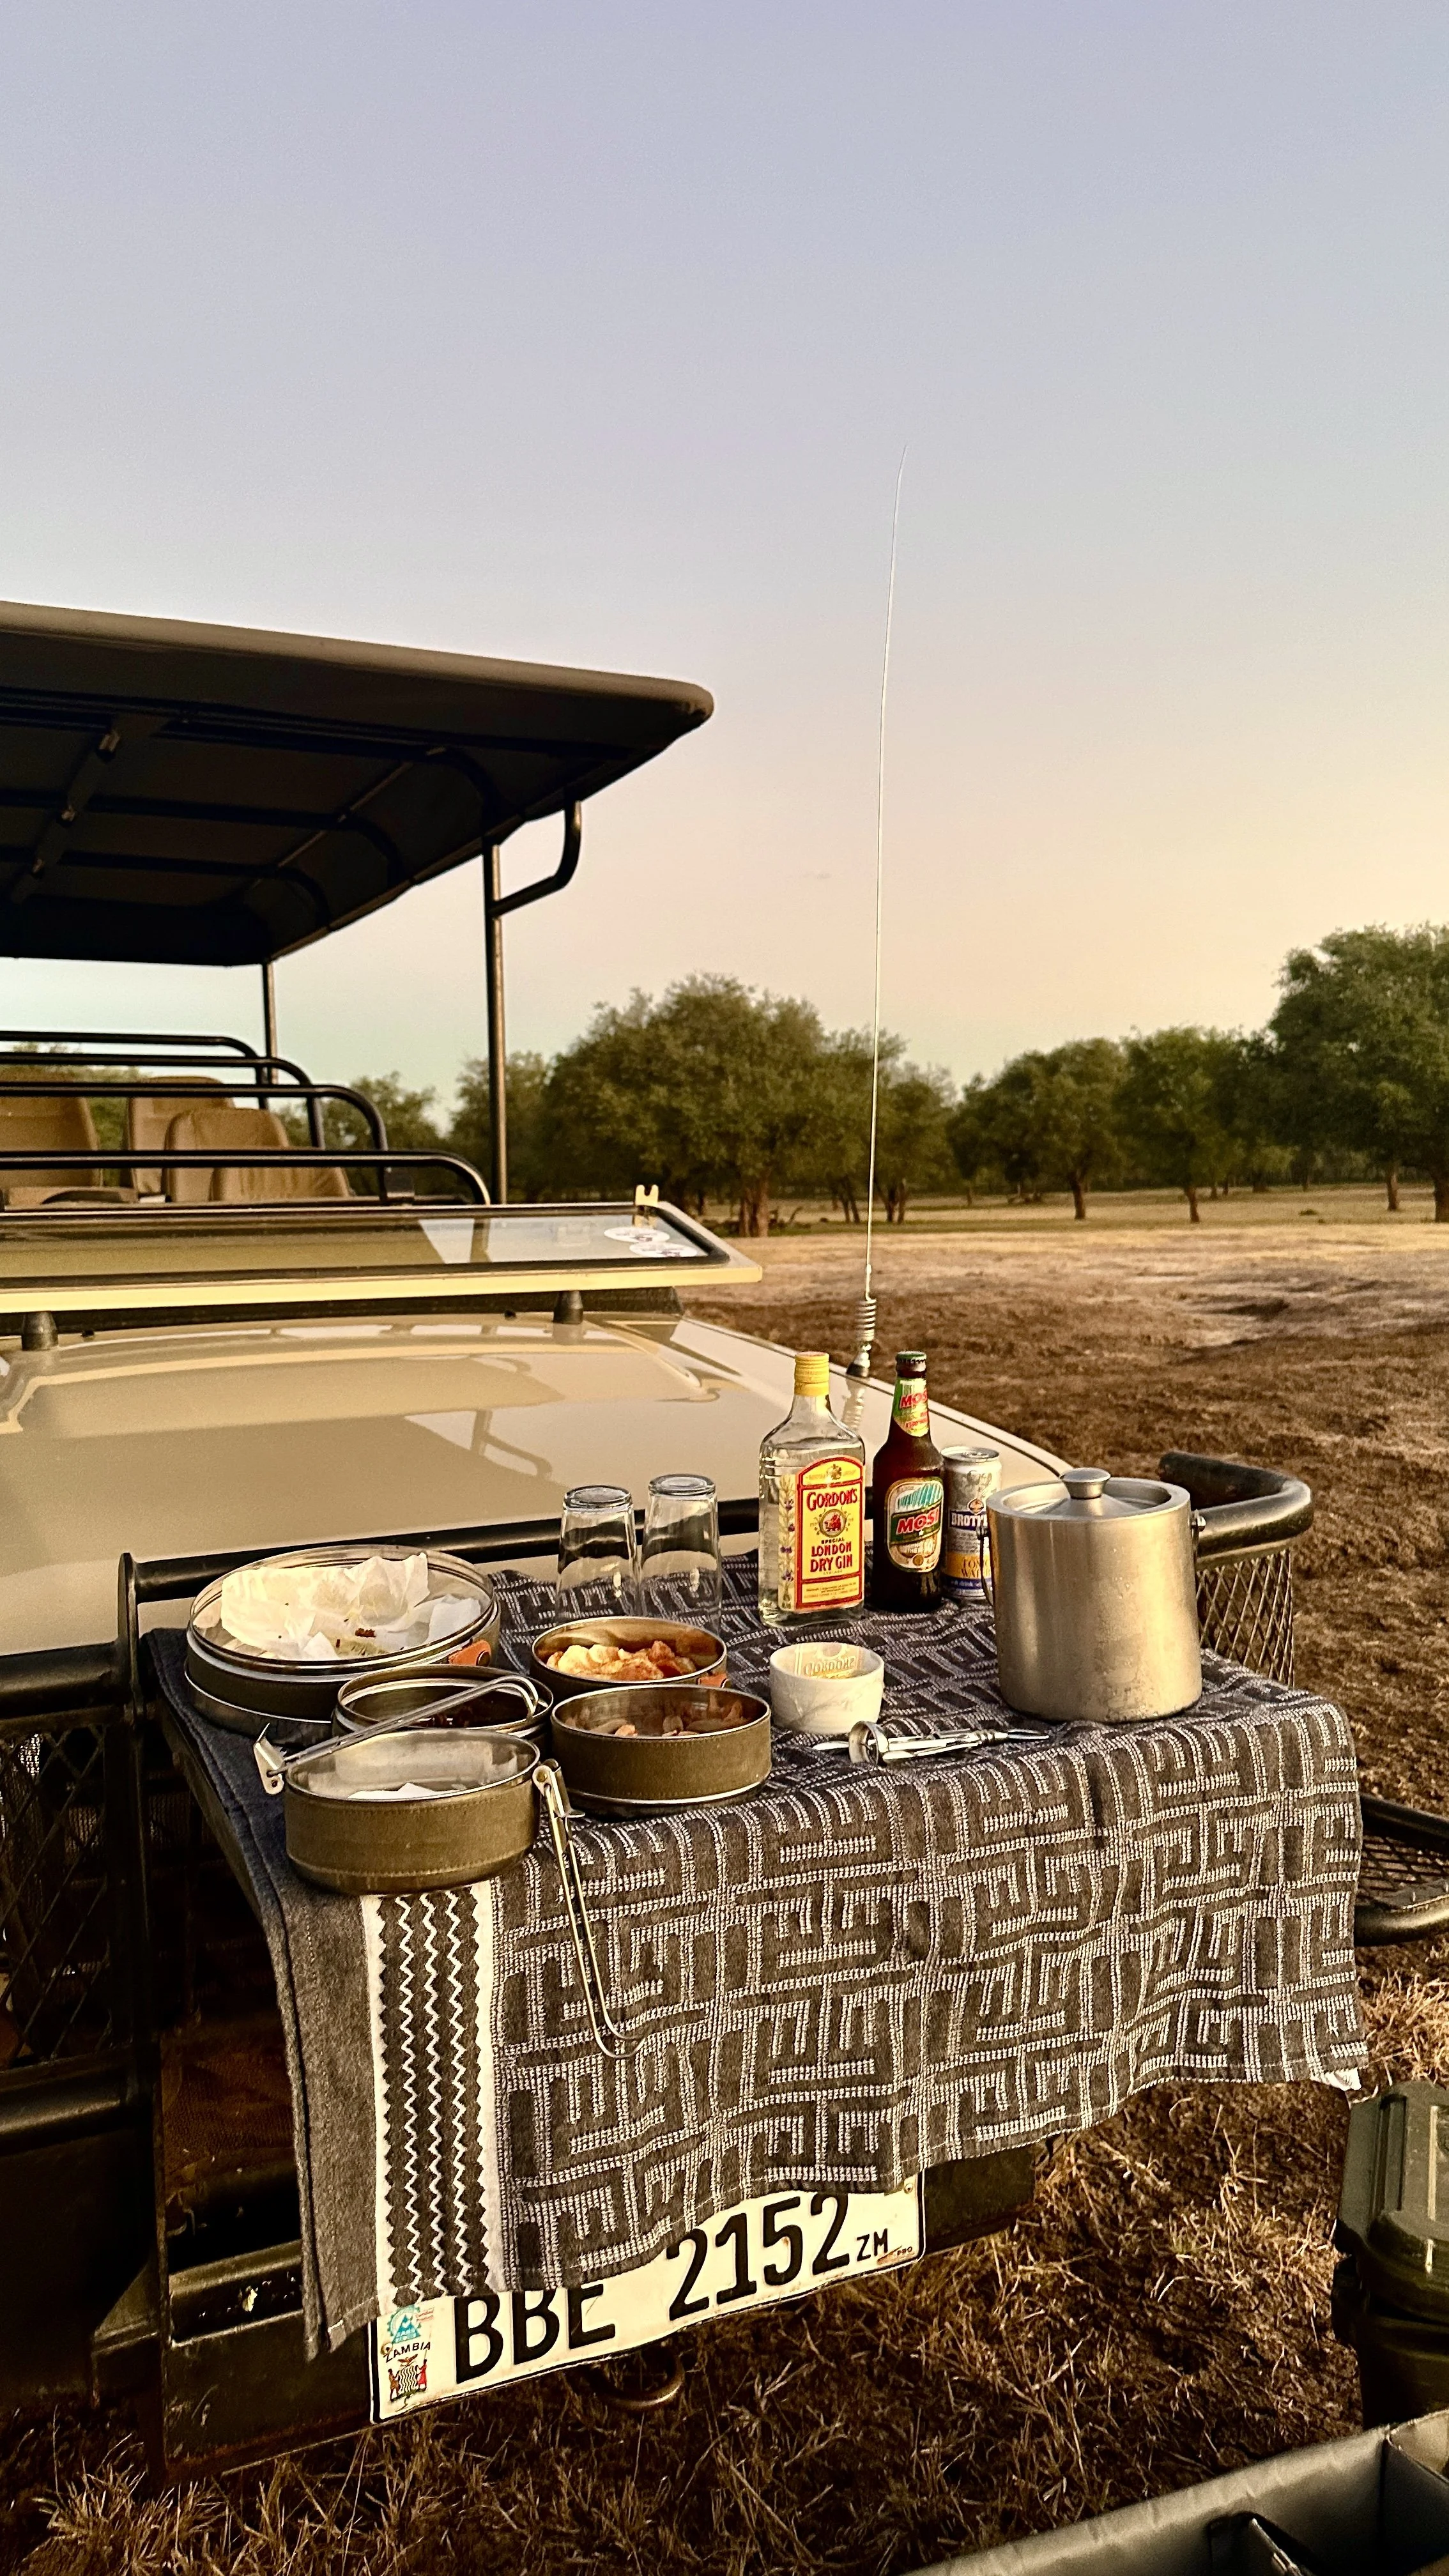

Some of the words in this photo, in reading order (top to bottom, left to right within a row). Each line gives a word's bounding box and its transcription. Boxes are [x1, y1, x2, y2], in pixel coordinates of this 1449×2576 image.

[896, 1505, 940, 1535] MOSI
[811, 1541, 852, 1557] LONDON
[810, 1556, 834, 1572] DRY
[836, 1554, 852, 1570] GIN
[454, 2283, 615, 2384] BBE
[666, 2193, 850, 2321] 2152
[857, 2228, 888, 2261] ZM
[383, 2342, 431, 2363] ZAMBIA
